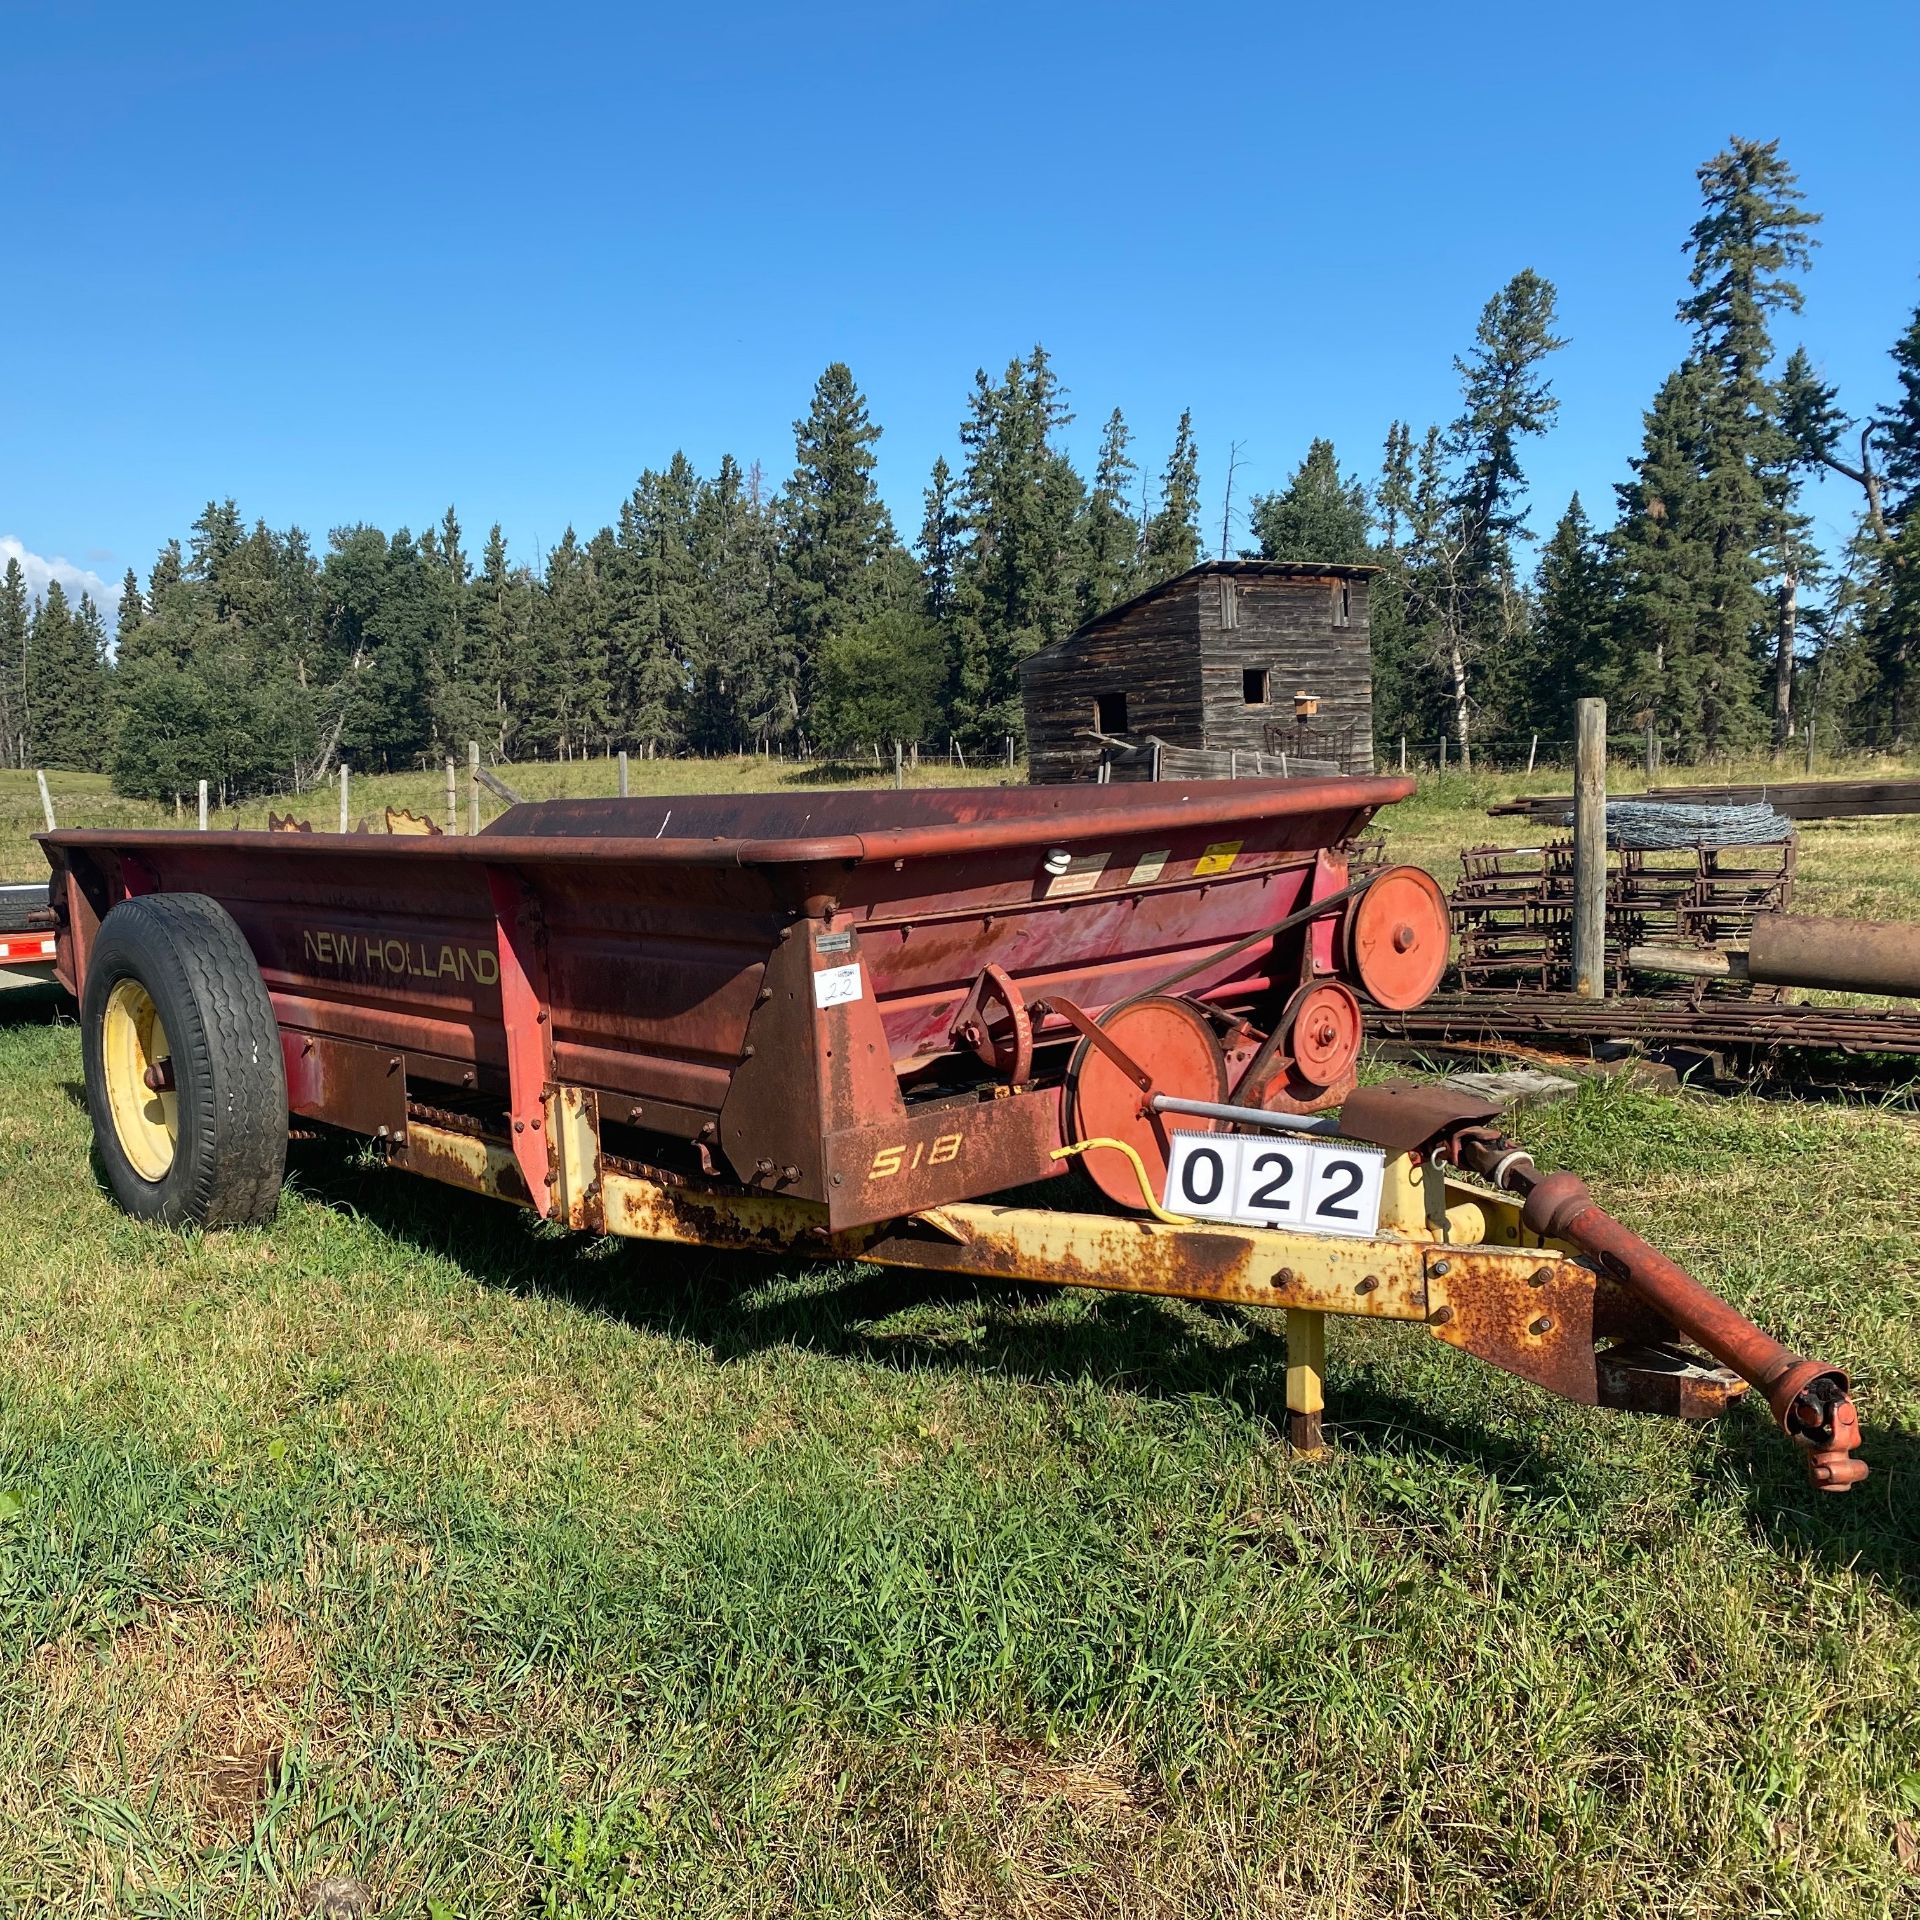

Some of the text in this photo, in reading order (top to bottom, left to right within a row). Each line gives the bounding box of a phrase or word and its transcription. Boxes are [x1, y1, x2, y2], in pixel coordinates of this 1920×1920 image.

[304, 930, 499, 985] NEW HOLLAND
[825, 978, 853, 1001] 22
[868, 1132, 963, 1180] 518
[1181, 1147, 1364, 1220] 022
